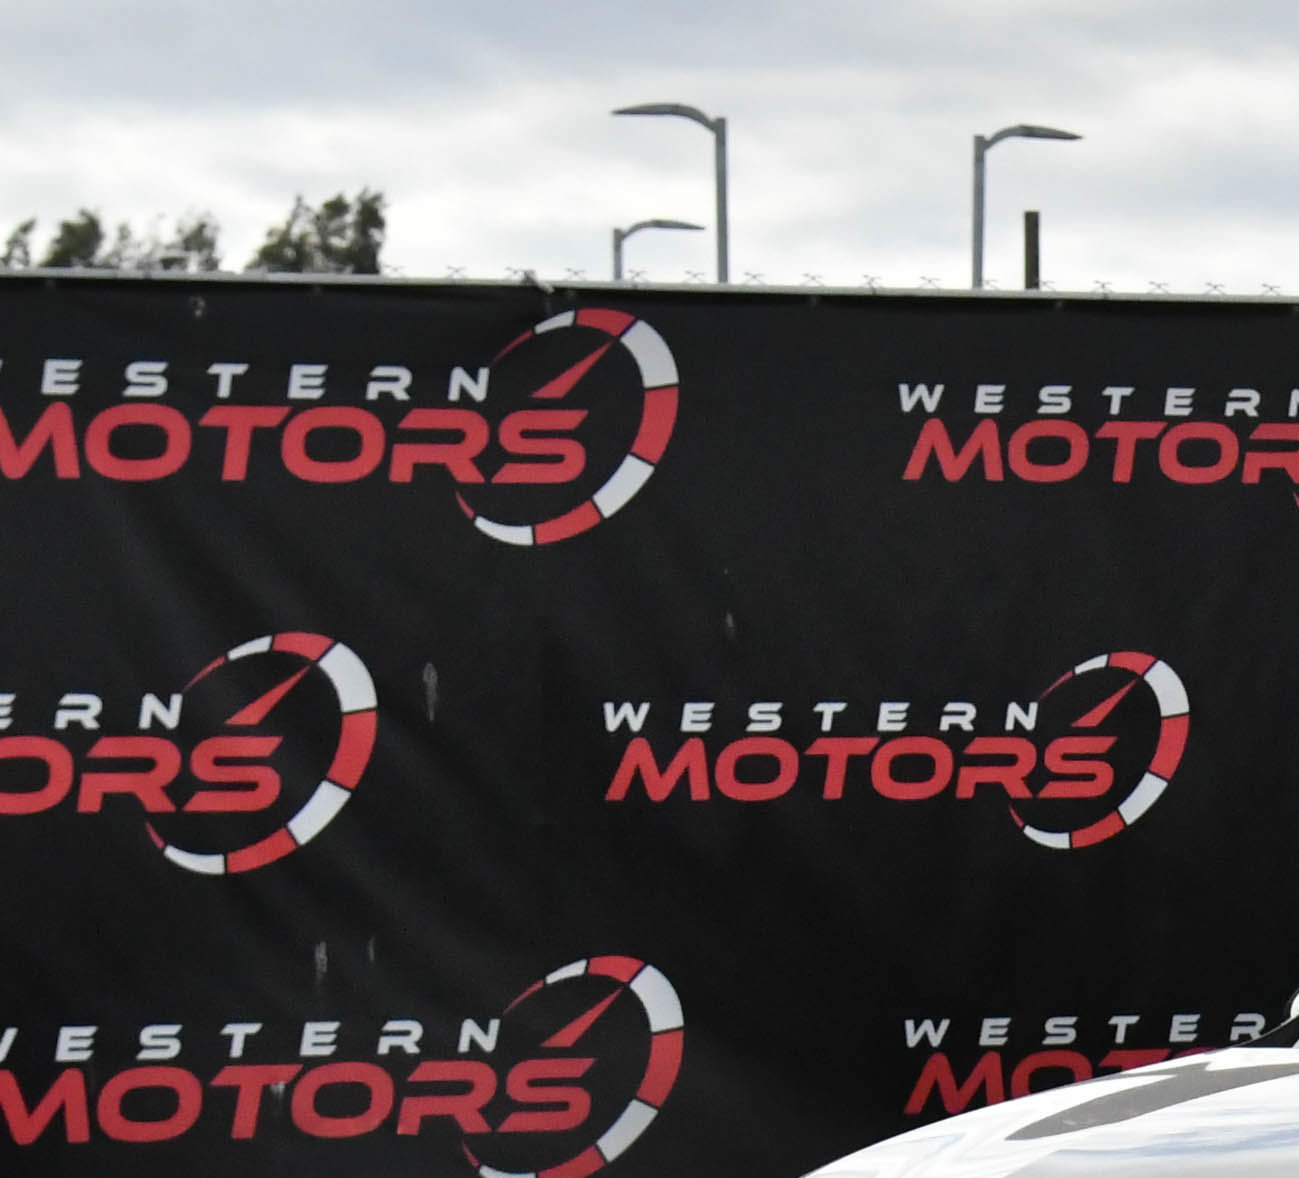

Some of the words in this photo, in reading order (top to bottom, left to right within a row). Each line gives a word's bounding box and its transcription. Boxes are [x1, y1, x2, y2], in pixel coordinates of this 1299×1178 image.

[0, 358, 490, 402] ESTERN
[603, 701, 1039, 733] WESTERN
[0, 735, 283, 815] ORS
[606, 735, 1118, 802] MOTORS
[904, 1013, 1265, 1048] WESTER
[0, 1057, 595, 1145] MOTORS
